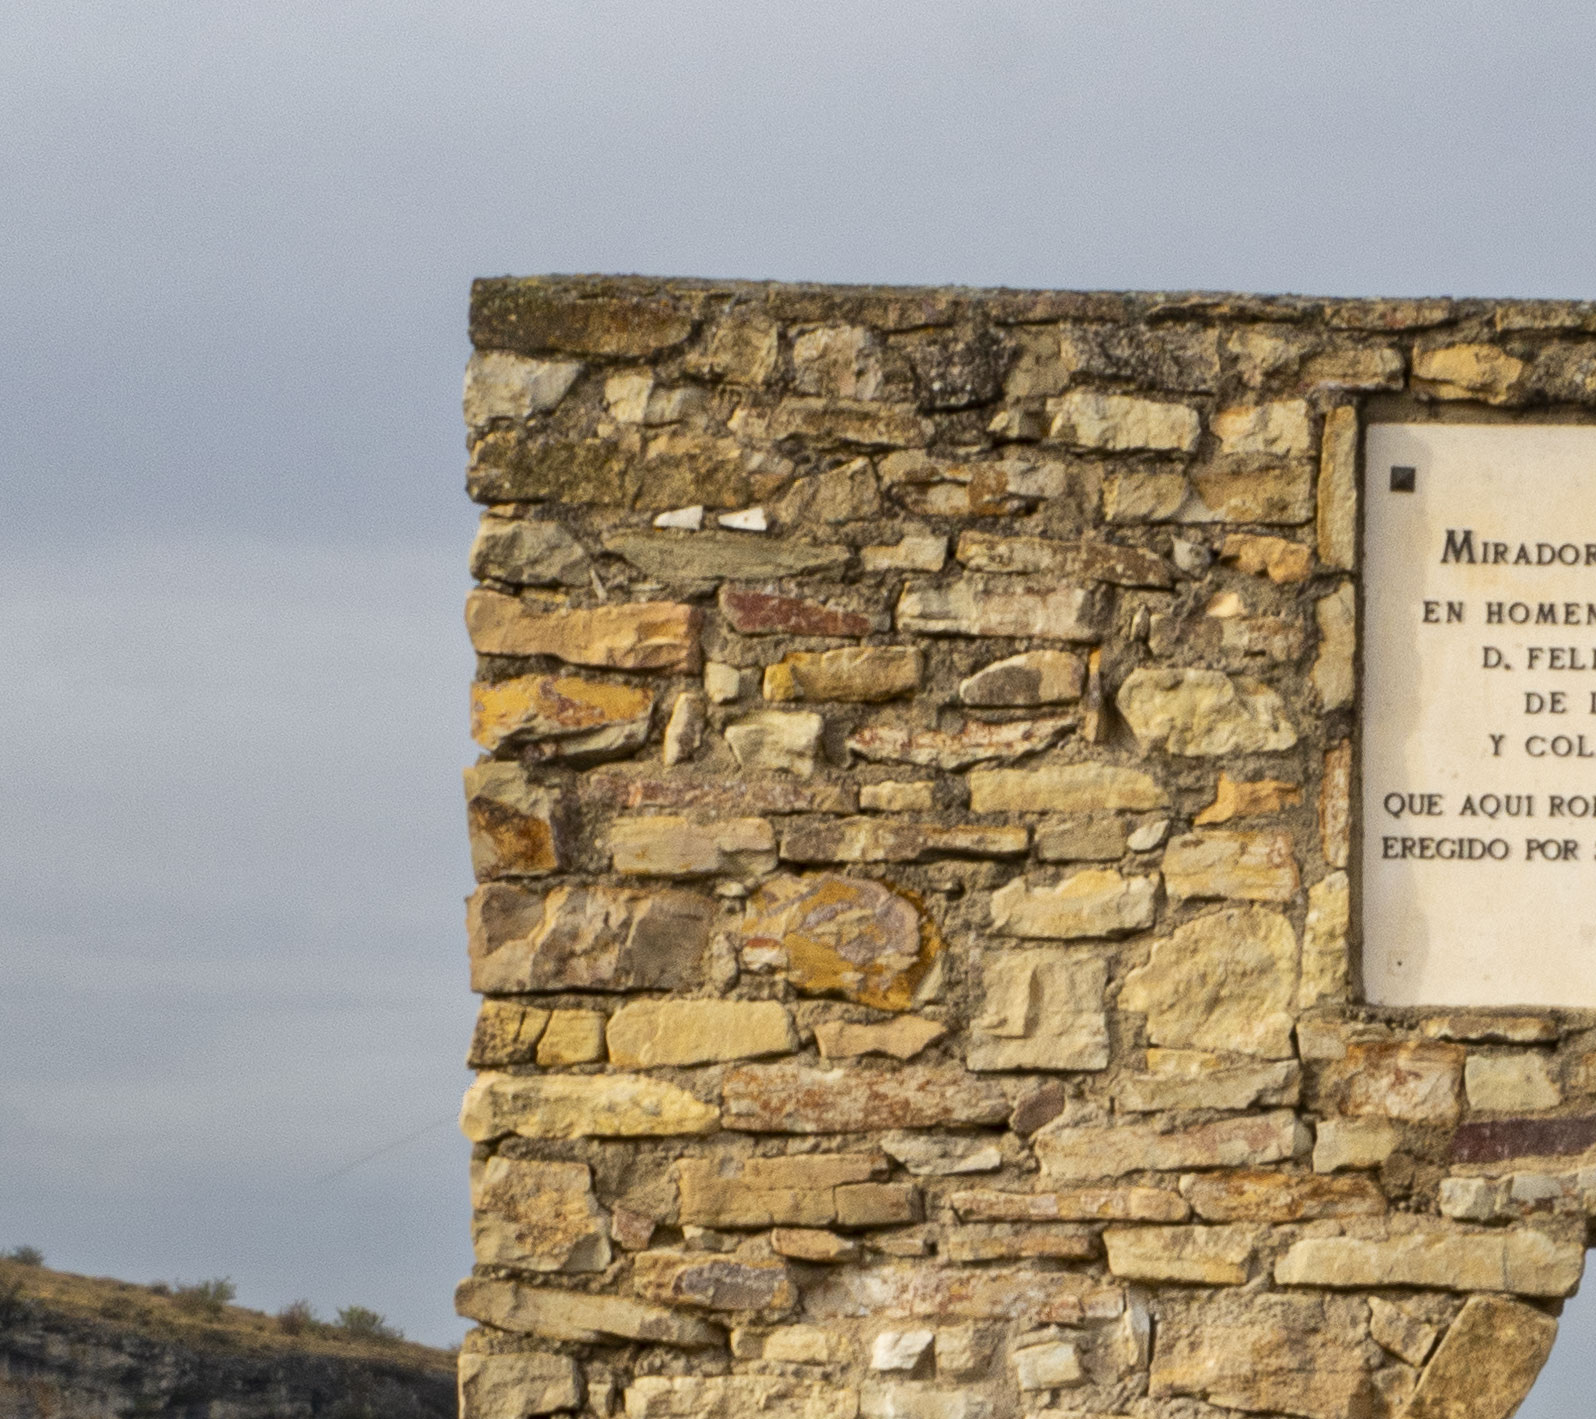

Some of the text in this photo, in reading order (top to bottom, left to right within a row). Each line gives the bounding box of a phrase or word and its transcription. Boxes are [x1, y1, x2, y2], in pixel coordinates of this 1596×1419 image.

[1422, 600, 1464, 625] EN
[1482, 645, 1512, 672] D.
[1524, 691, 1568, 715] DE
[1488, 733, 1506, 758] Y
[1382, 791, 1444, 820] QUE
[1458, 793, 1535, 820] AQUI
[1379, 835, 1510, 861] EREGIDO
[1525, 838, 1579, 862] POR
